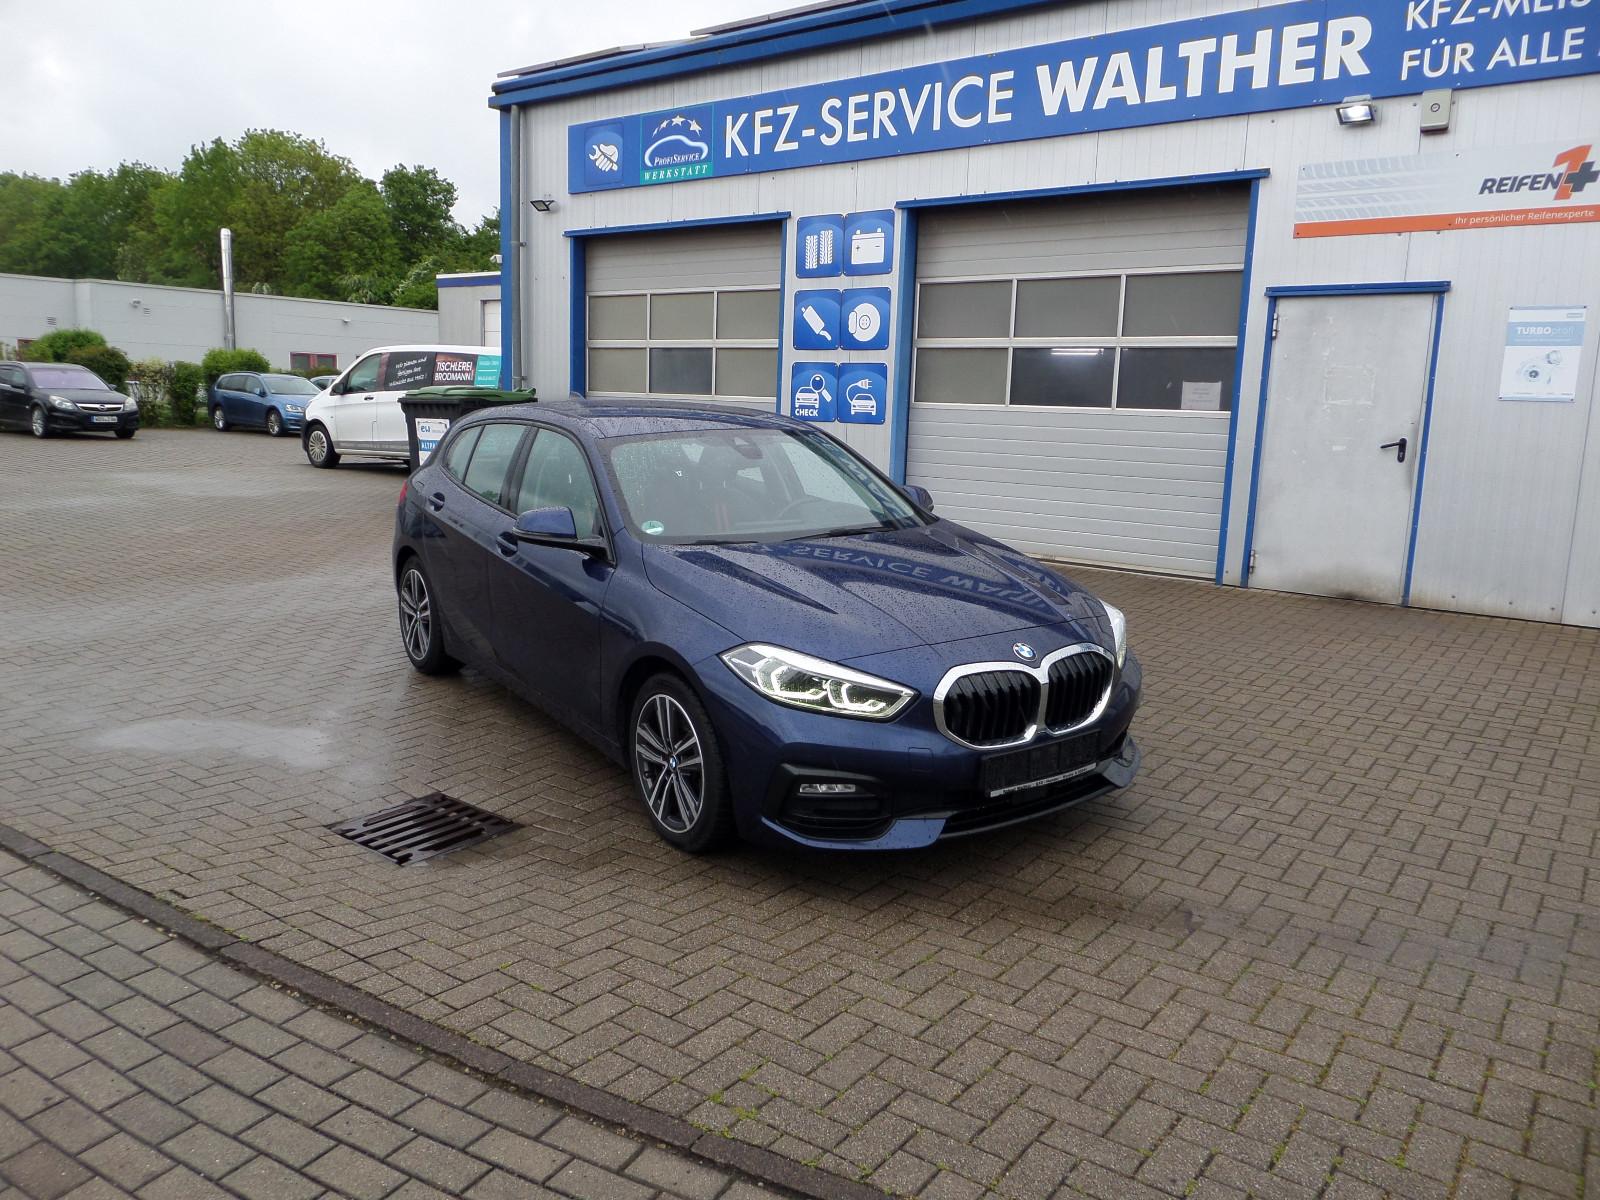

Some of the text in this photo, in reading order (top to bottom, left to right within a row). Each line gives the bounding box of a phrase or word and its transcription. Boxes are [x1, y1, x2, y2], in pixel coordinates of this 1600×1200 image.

[1401, 26, 1586, 81] FÜR ALLE
[724, 15, 1373, 158] KFZ-SERVICE WALTHER
[644, 164, 708, 181] WERKSTATT
[1455, 208, 1595, 225] Ihr persönlicher Reifenexperte
[436, 361, 473, 372] TISCHLEREI
[794, 408, 819, 417] CHECK
